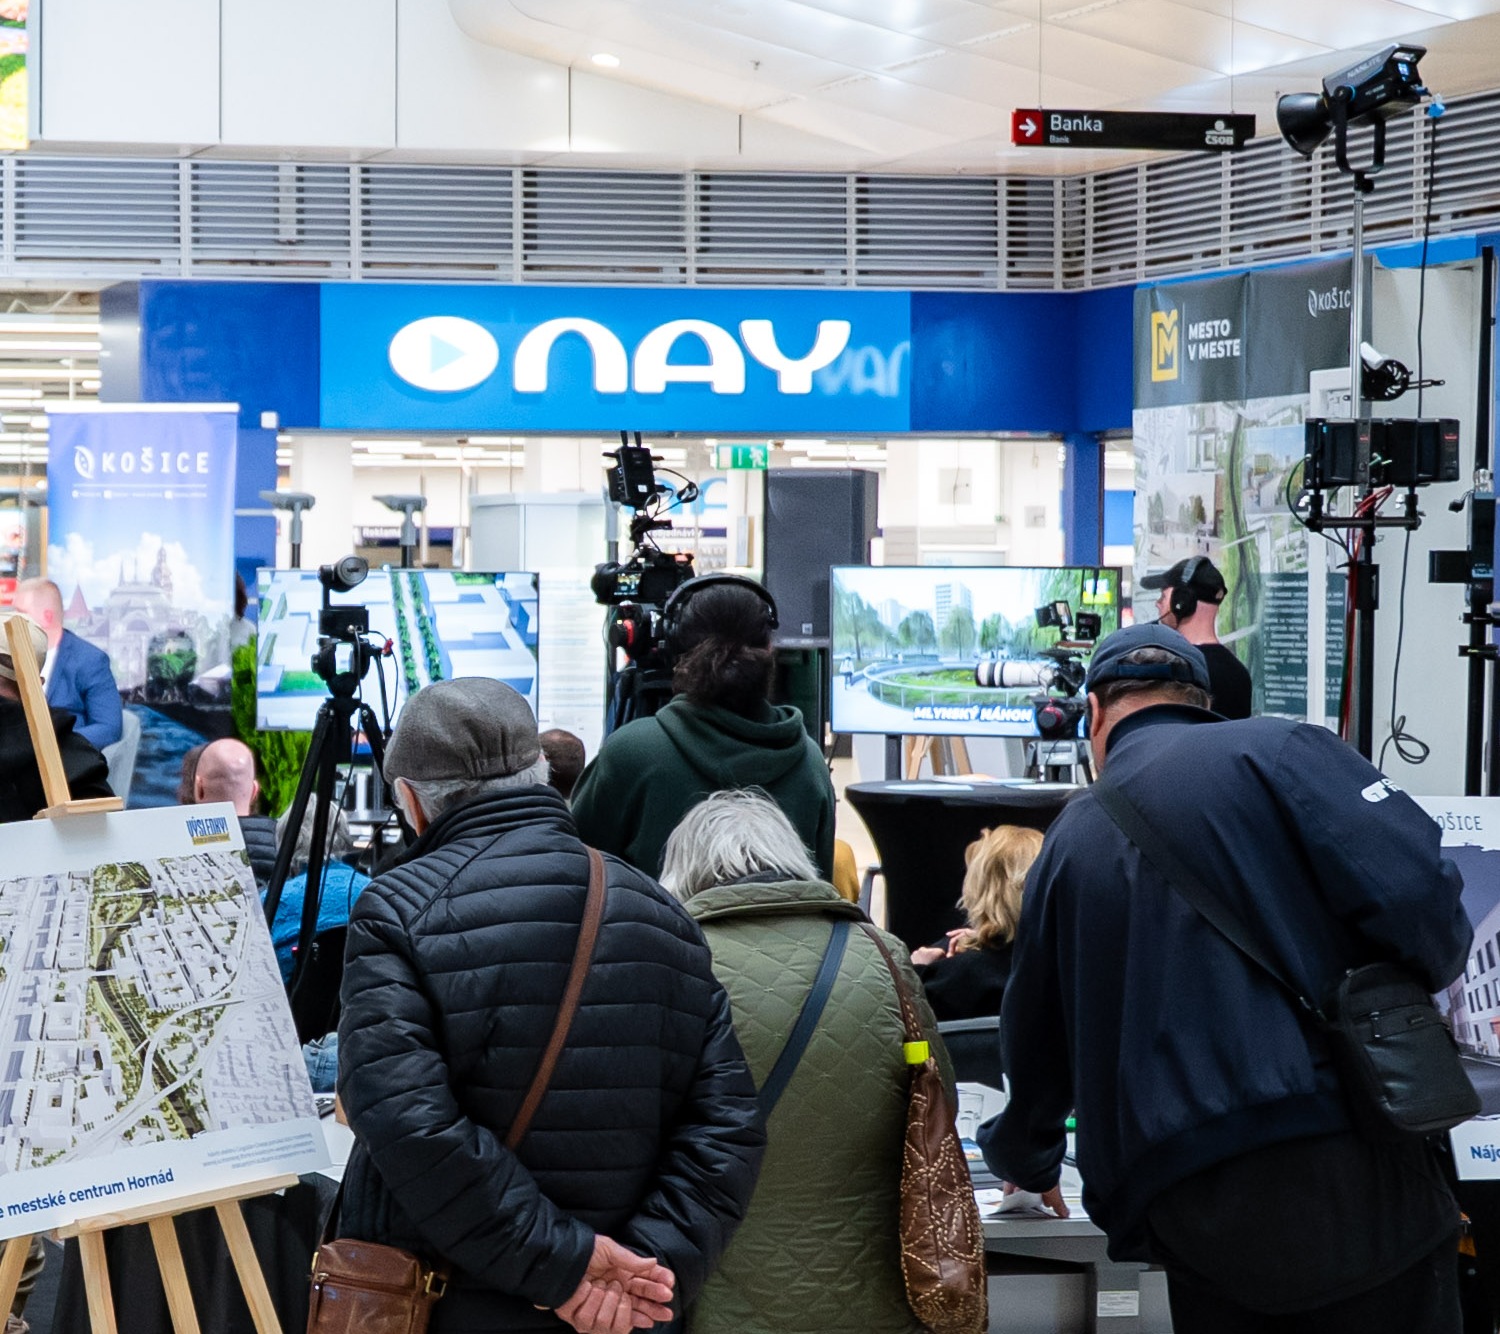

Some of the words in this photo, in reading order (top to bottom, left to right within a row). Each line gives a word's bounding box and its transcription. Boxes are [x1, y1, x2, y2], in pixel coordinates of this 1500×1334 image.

[1050, 114, 1103, 132] Banka
[1049, 134, 1070, 144] Bank
[1205, 135, 1234, 145] ČSOB
[1318, 287, 1353, 312] KOŠIC
[1188, 318, 1231, 340] MESTO
[512, 317, 852, 395] NAY
[1188, 344, 1197, 361] V
[1199, 338, 1241, 357] MESTE
[102, 447, 209, 473] KOŠICE
[914, 705, 979, 720] MLYNSKÝ
[980, 707, 1033, 722] NÁHON
[7, 1190, 66, 1216] mestské
[69, 1178, 126, 1203] centrum
[127, 1167, 175, 1191] Hornád
